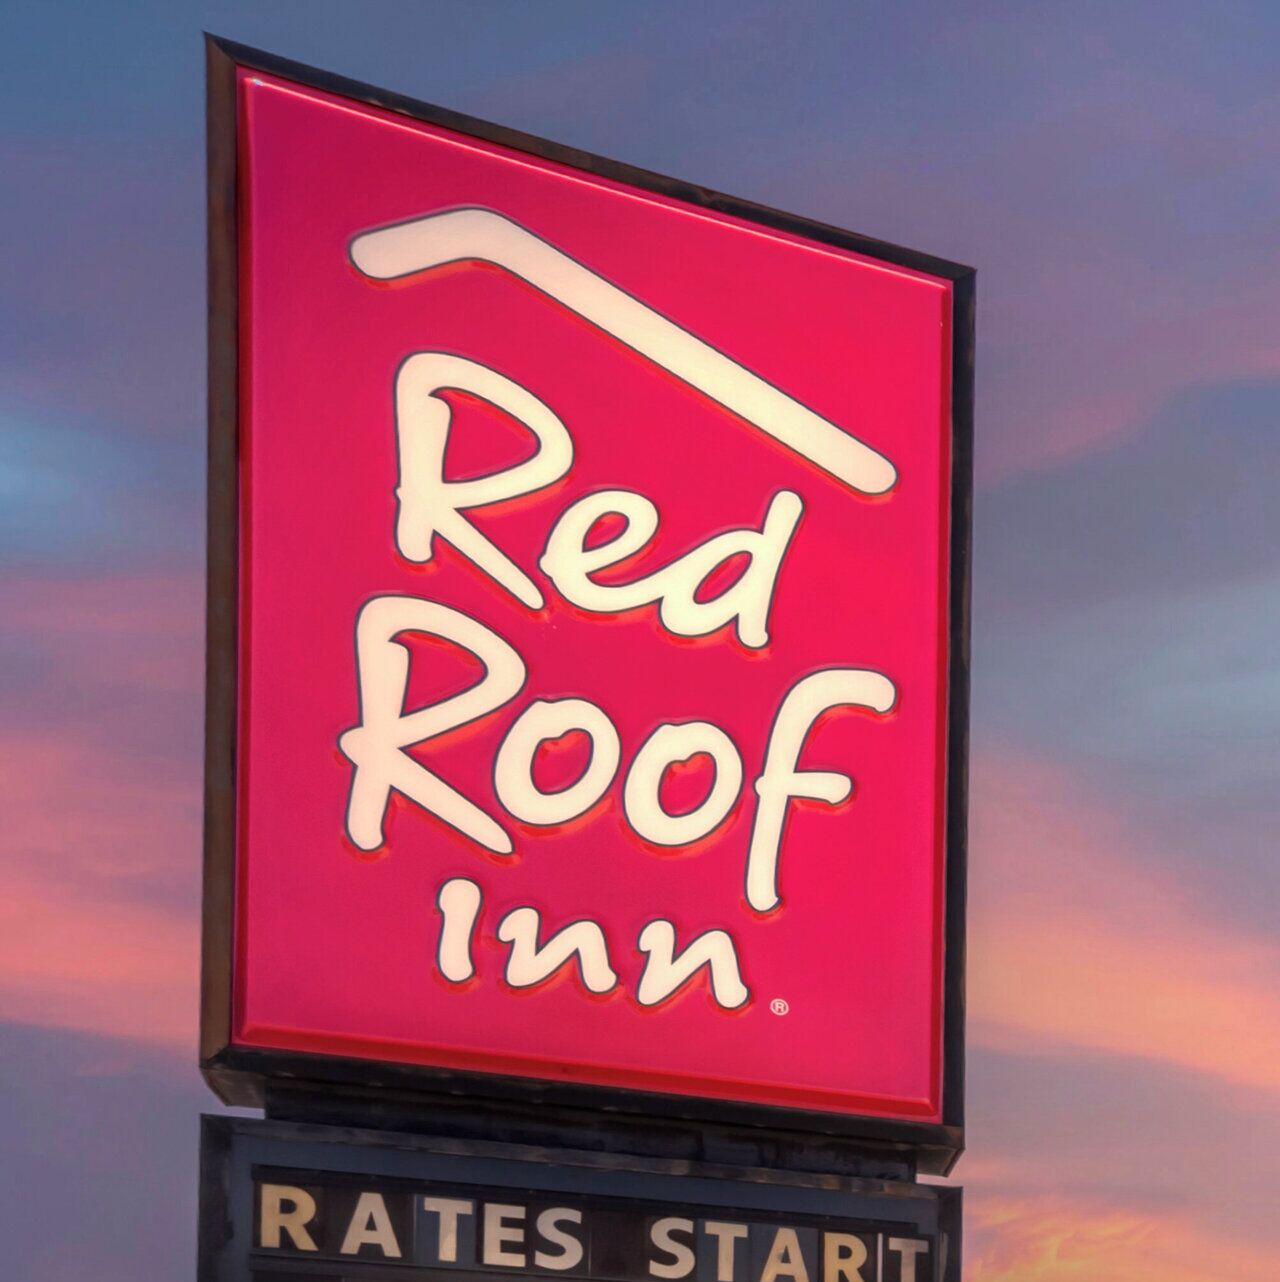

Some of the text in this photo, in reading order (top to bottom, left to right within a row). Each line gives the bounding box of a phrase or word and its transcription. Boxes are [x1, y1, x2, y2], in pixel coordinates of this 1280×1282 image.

[394, 350, 804, 650] Red
[337, 598, 898, 913] Roof
[258, 1183, 584, 1270] RATES
